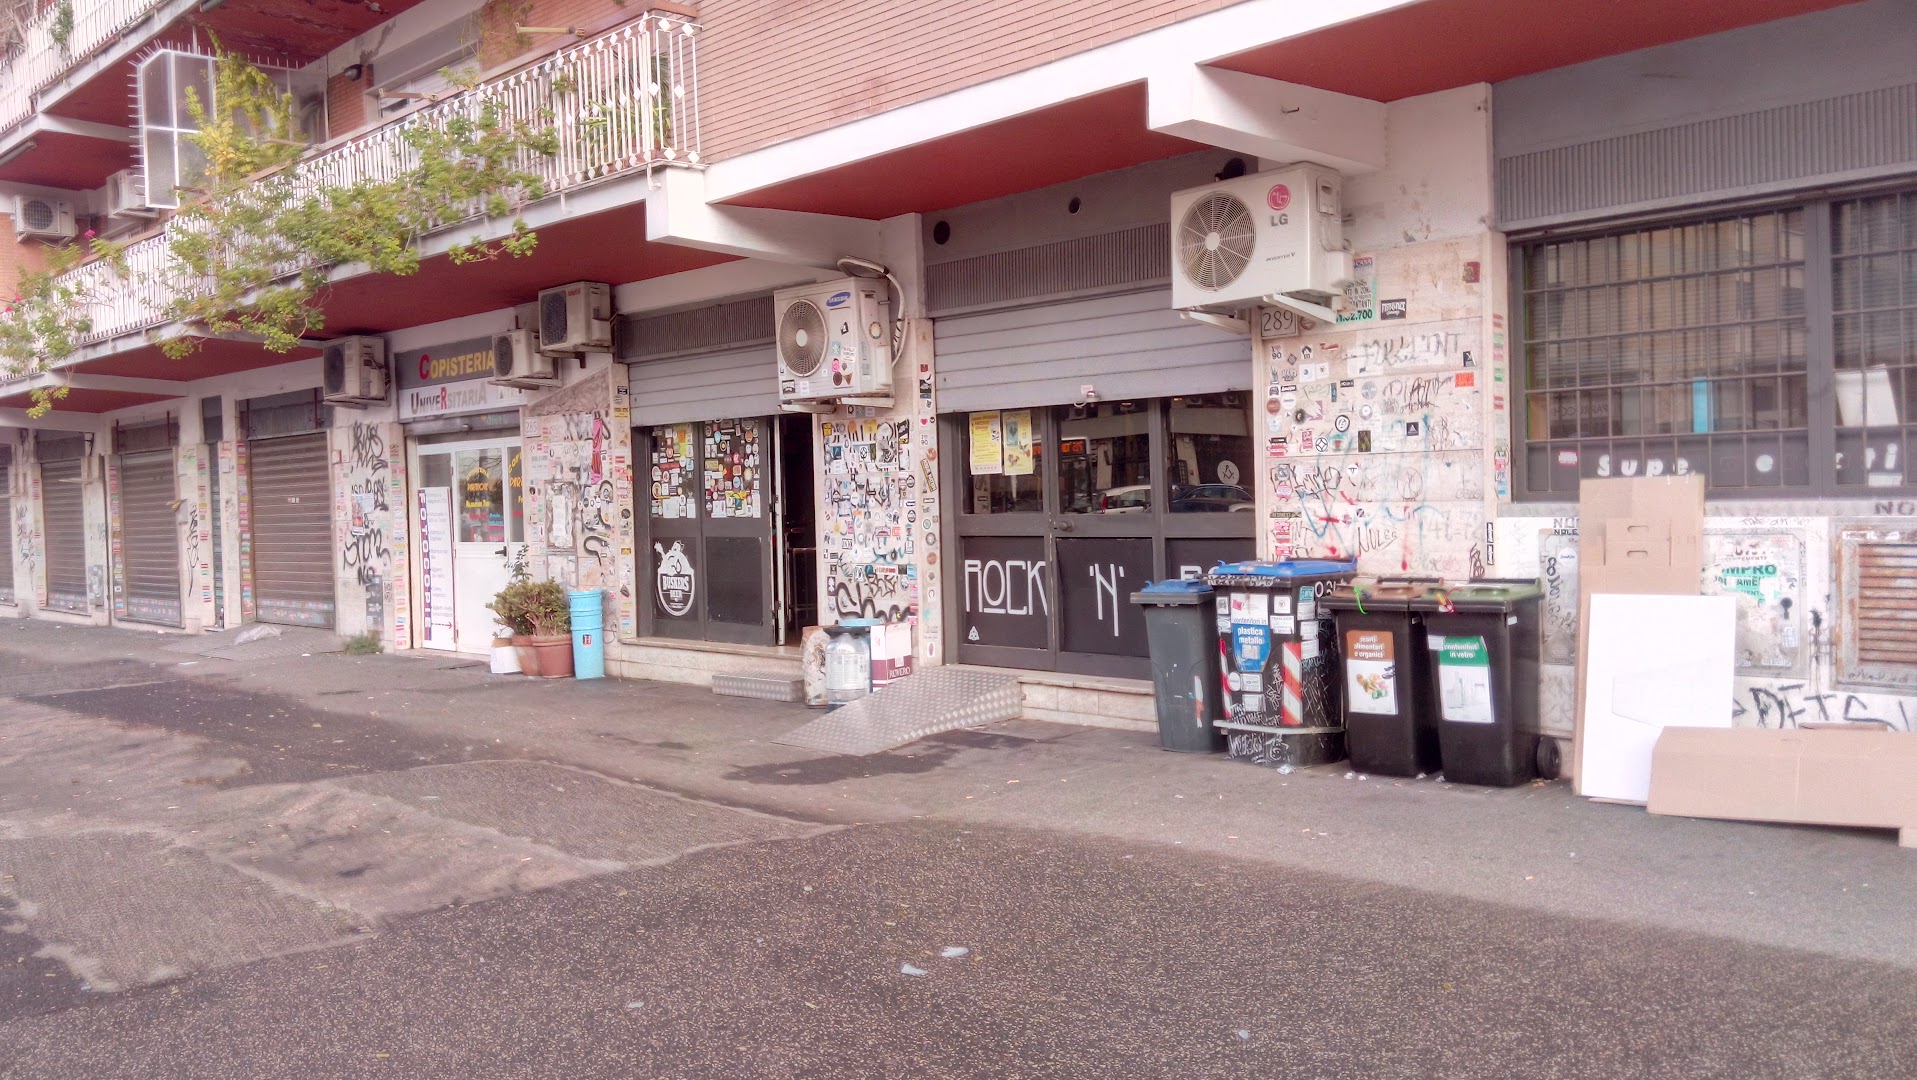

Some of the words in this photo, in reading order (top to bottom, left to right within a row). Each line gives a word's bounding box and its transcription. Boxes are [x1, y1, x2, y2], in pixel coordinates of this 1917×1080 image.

[1270, 213, 1288, 227] LG
[1262, 309, 1294, 331] 289
[419, 350, 494, 380] COPISTERIA
[411, 381, 487, 414] UNIVERSITARIA
[419, 491, 432, 629] FOTOCOPIE
[662, 575, 689, 592] BUSKERS
[965, 560, 1048, 616] ROCK
[1237, 626, 1263, 637] plastica
[1238, 637, 1263, 645] metallo
[1360, 635, 1376, 643] scarti
[1444, 642, 1477, 650] contenitori
[1354, 642, 1383, 651] alimentari
[1359, 650, 1383, 659] organici
